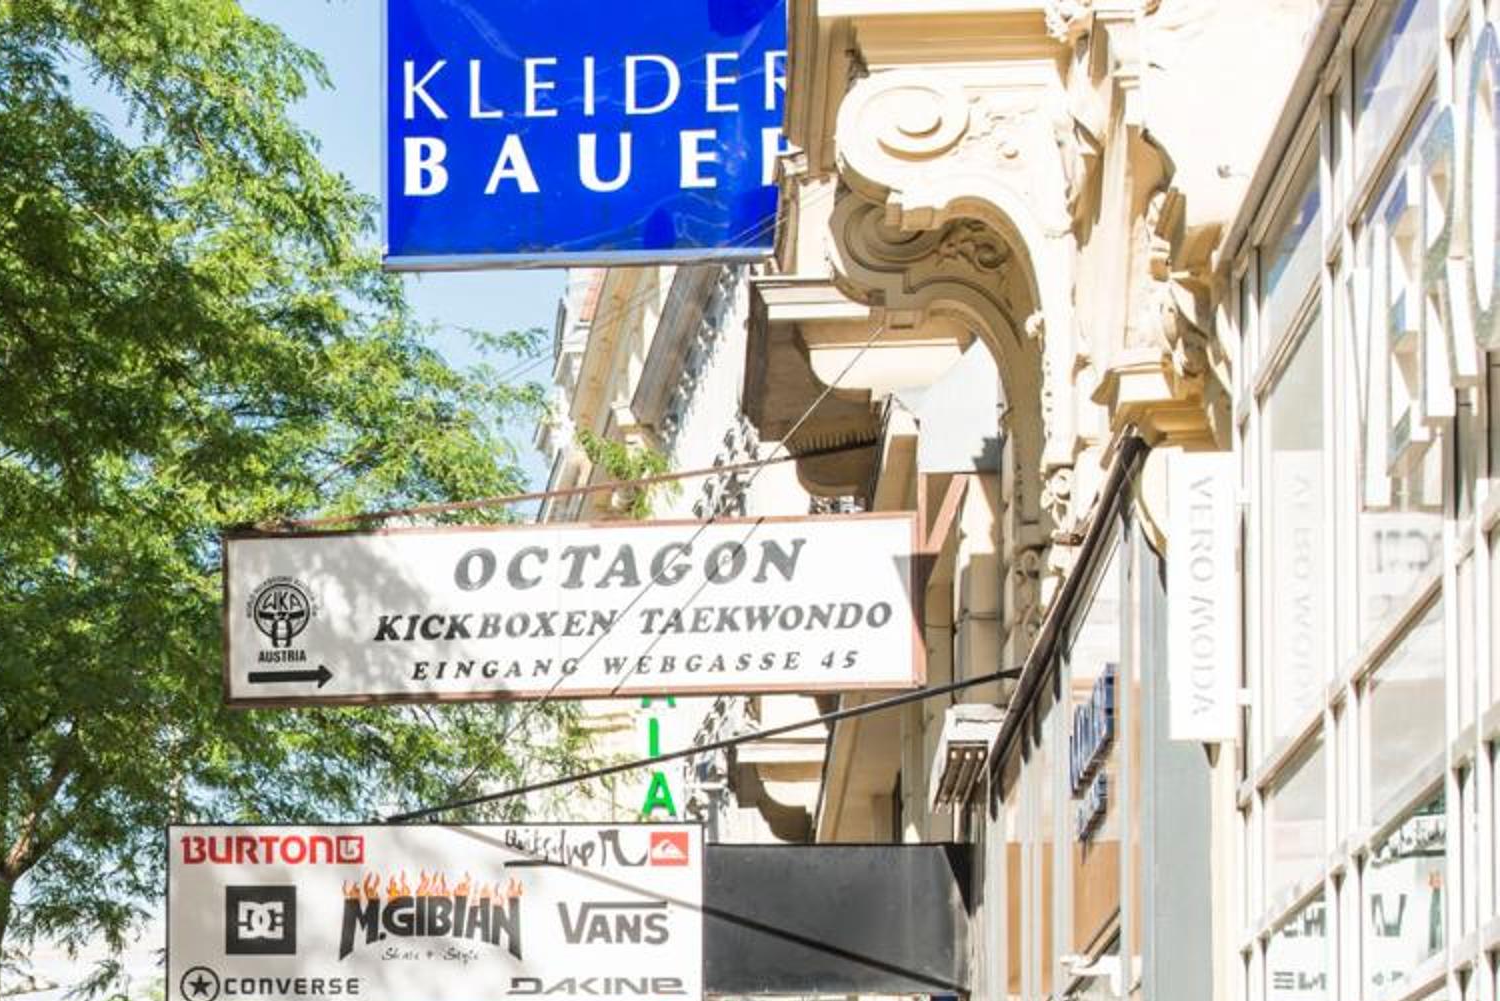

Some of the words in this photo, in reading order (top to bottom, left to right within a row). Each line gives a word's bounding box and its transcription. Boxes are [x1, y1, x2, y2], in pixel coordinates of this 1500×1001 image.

[454, 538, 806, 591] OCTAGON
[374, 609, 618, 642] KICKBOXEN
[639, 602, 893, 635] TAEKWONDO
[258, 650, 307, 663] AUSTRIA
[411, 657, 579, 681] EINGANG
[604, 652, 801, 675] WEBGASSE
[821, 650, 859, 669] 45
[180, 835, 334, 865] BURTON
[224, 977, 361, 995] CONVERSE
